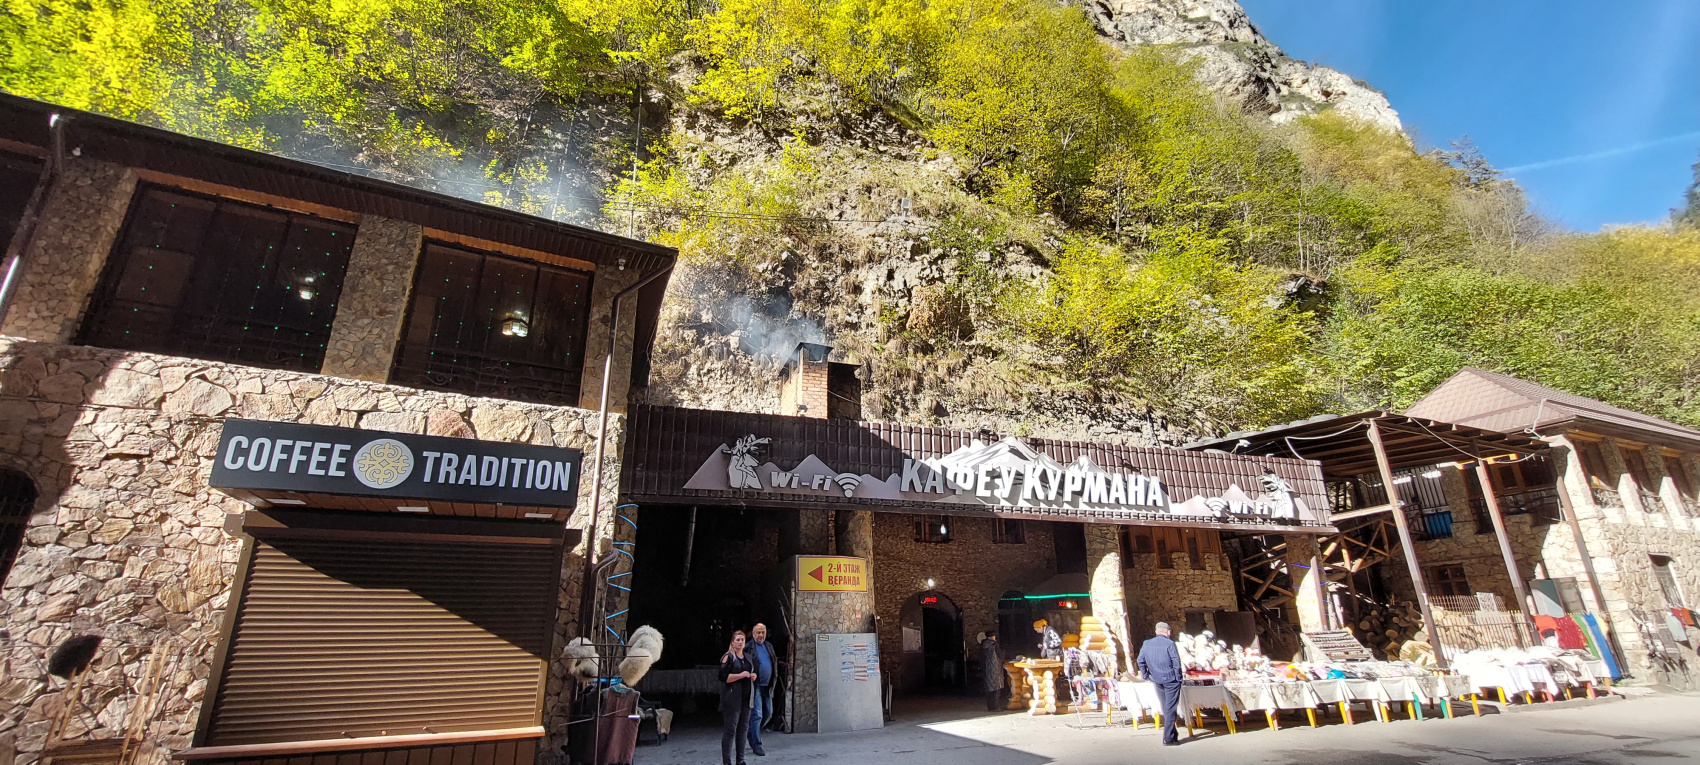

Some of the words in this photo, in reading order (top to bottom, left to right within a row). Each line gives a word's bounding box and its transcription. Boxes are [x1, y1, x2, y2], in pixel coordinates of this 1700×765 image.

[223, 435, 351, 477] COFFEE
[422, 451, 571, 491] TRADITION
[770, 471, 833, 491] Wi-Fi
[900, 459, 992, 497] КАФЕ
[1023, 463, 1164, 506] КУРМАНА
[1228, 500, 1269, 514] WiFi
[828, 562, 842, 573] 2-Й
[843, 564, 860, 574] ЭТАЖ
[828, 576, 861, 587] ВЕРАНДА
